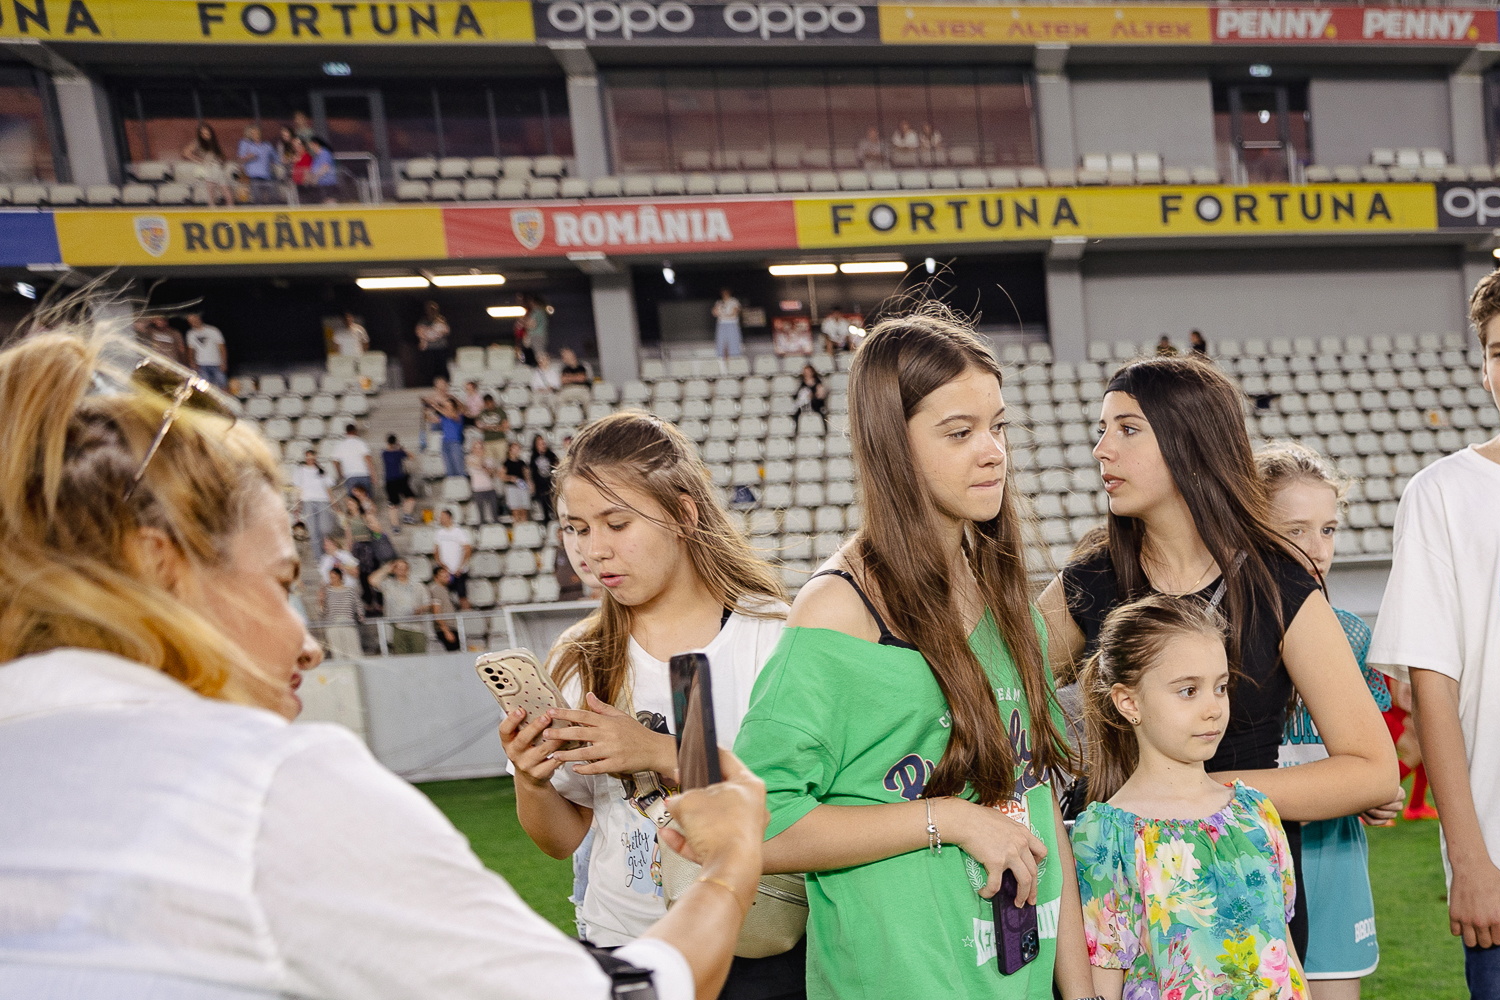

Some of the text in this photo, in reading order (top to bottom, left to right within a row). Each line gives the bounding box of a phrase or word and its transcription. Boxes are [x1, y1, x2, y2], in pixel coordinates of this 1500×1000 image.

[0, 0, 102, 37] NA
[197, 2, 484, 37] FORTUNA
[548, 2, 695, 40] oppo
[723, 2, 866, 40] oppo
[553, 204, 733, 247] ROMÂNIA
[830, 197, 1079, 235] FORTUNA
[1161, 193, 1394, 225] FORTUNA
[182, 212, 374, 251] ROMÂNIA
[625, 851, 648, 888] girl
